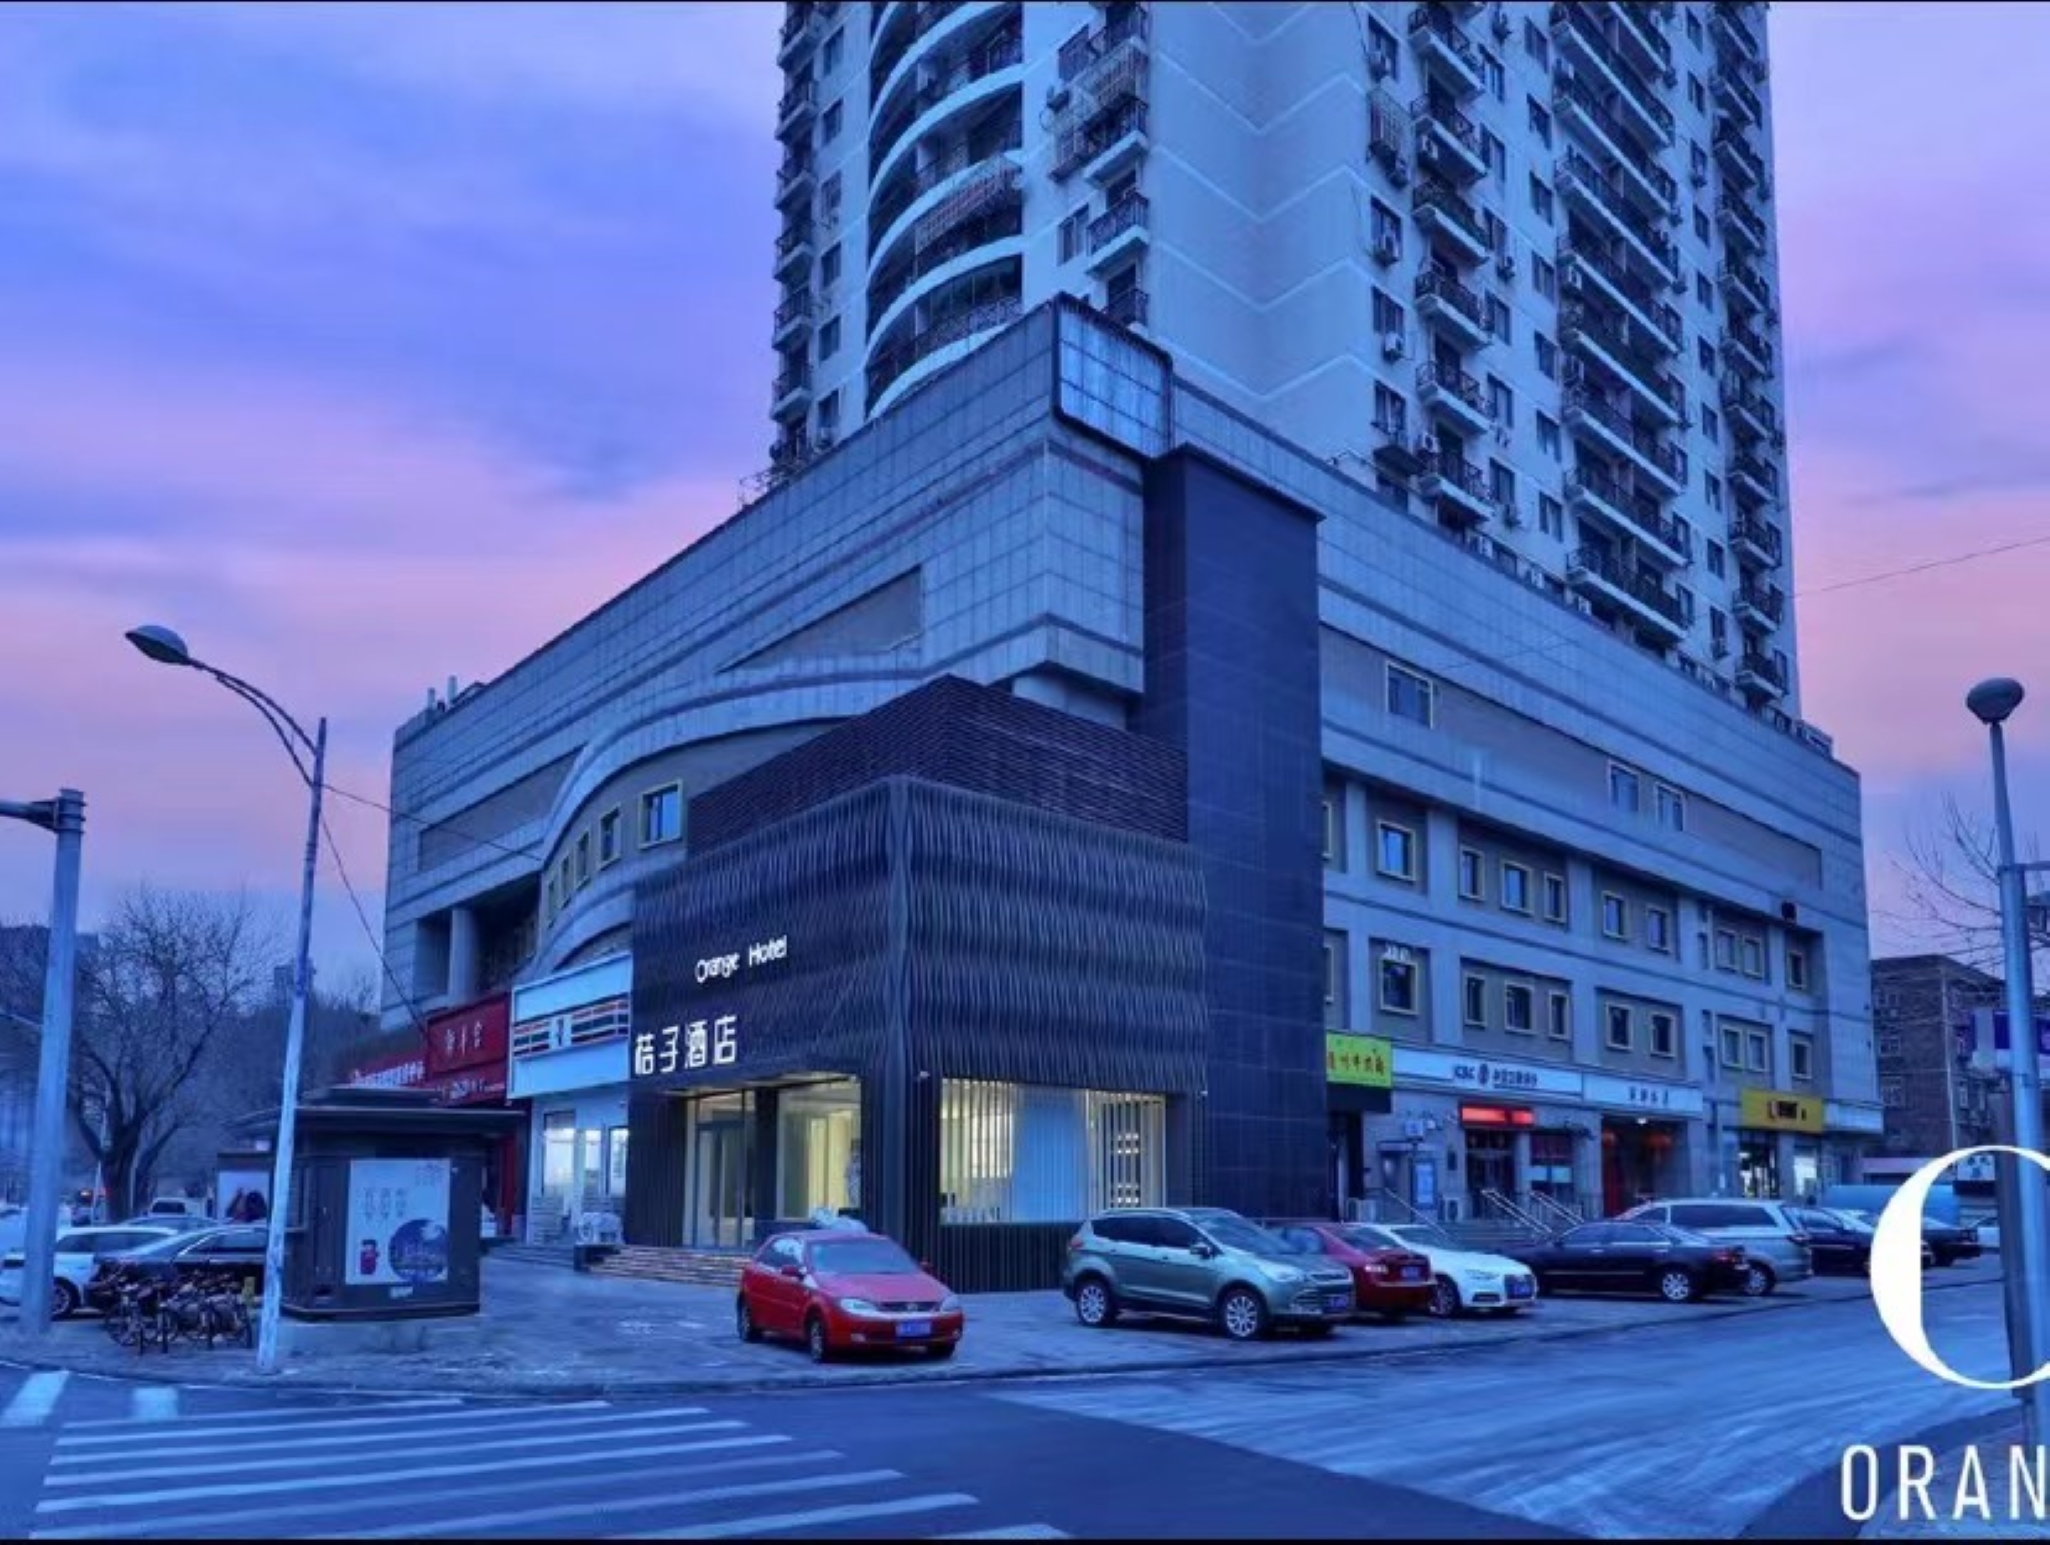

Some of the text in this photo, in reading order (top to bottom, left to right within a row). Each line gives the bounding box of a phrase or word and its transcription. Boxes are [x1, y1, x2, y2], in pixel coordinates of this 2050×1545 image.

[695, 935, 789, 984] Orange Hotel
[633, 1014, 738, 1076] 桔子酒店
